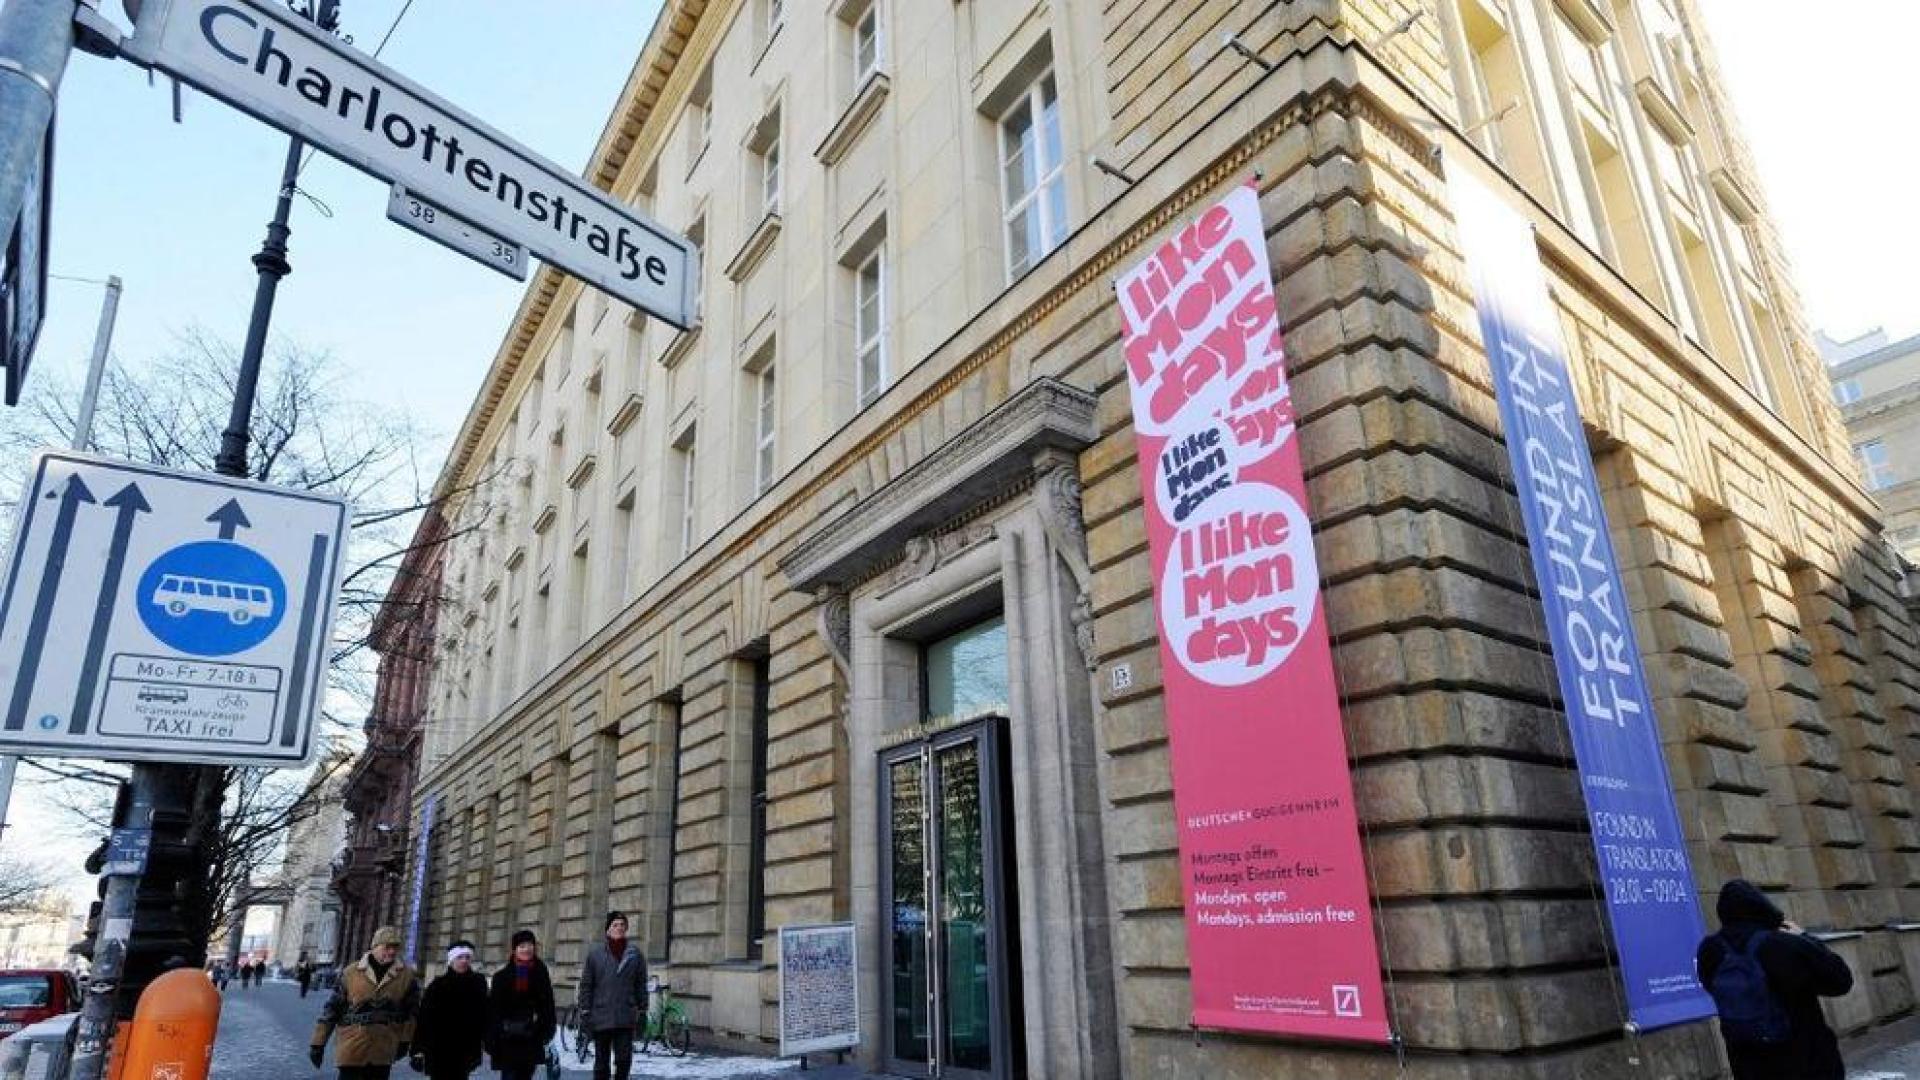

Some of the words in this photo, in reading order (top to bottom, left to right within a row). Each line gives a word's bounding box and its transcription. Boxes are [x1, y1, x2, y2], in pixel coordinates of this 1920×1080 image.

[200, 4, 668, 286] Charlottenstraße
[408, 201, 435, 223] 38
[492, 241, 514, 264] 35
[1127, 205, 1233, 323] like
[1125, 238, 1256, 386] Mon
[1150, 281, 1276, 424] days
[1500, 340, 1541, 417] IN
[1162, 453, 1171, 475] I
[1172, 428, 1220, 468] like
[1167, 448, 1227, 500] Mon
[1180, 529, 1193, 570] I
[1200, 511, 1289, 566] like
[1183, 552, 1294, 618] Mon
[1525, 437, 1613, 722] FOUND
[1186, 606, 1299, 668] days
[137, 662, 198, 679] Mo-Fr
[144, 716, 192, 735] TAXI
[201, 722, 234, 737] frei
[1193, 869, 1243, 887] Montags
[1296, 862, 1320, 877] frei
[1254, 890, 1287, 905] open
[1257, 907, 1322, 925] admission
[1326, 904, 1356, 922] free
